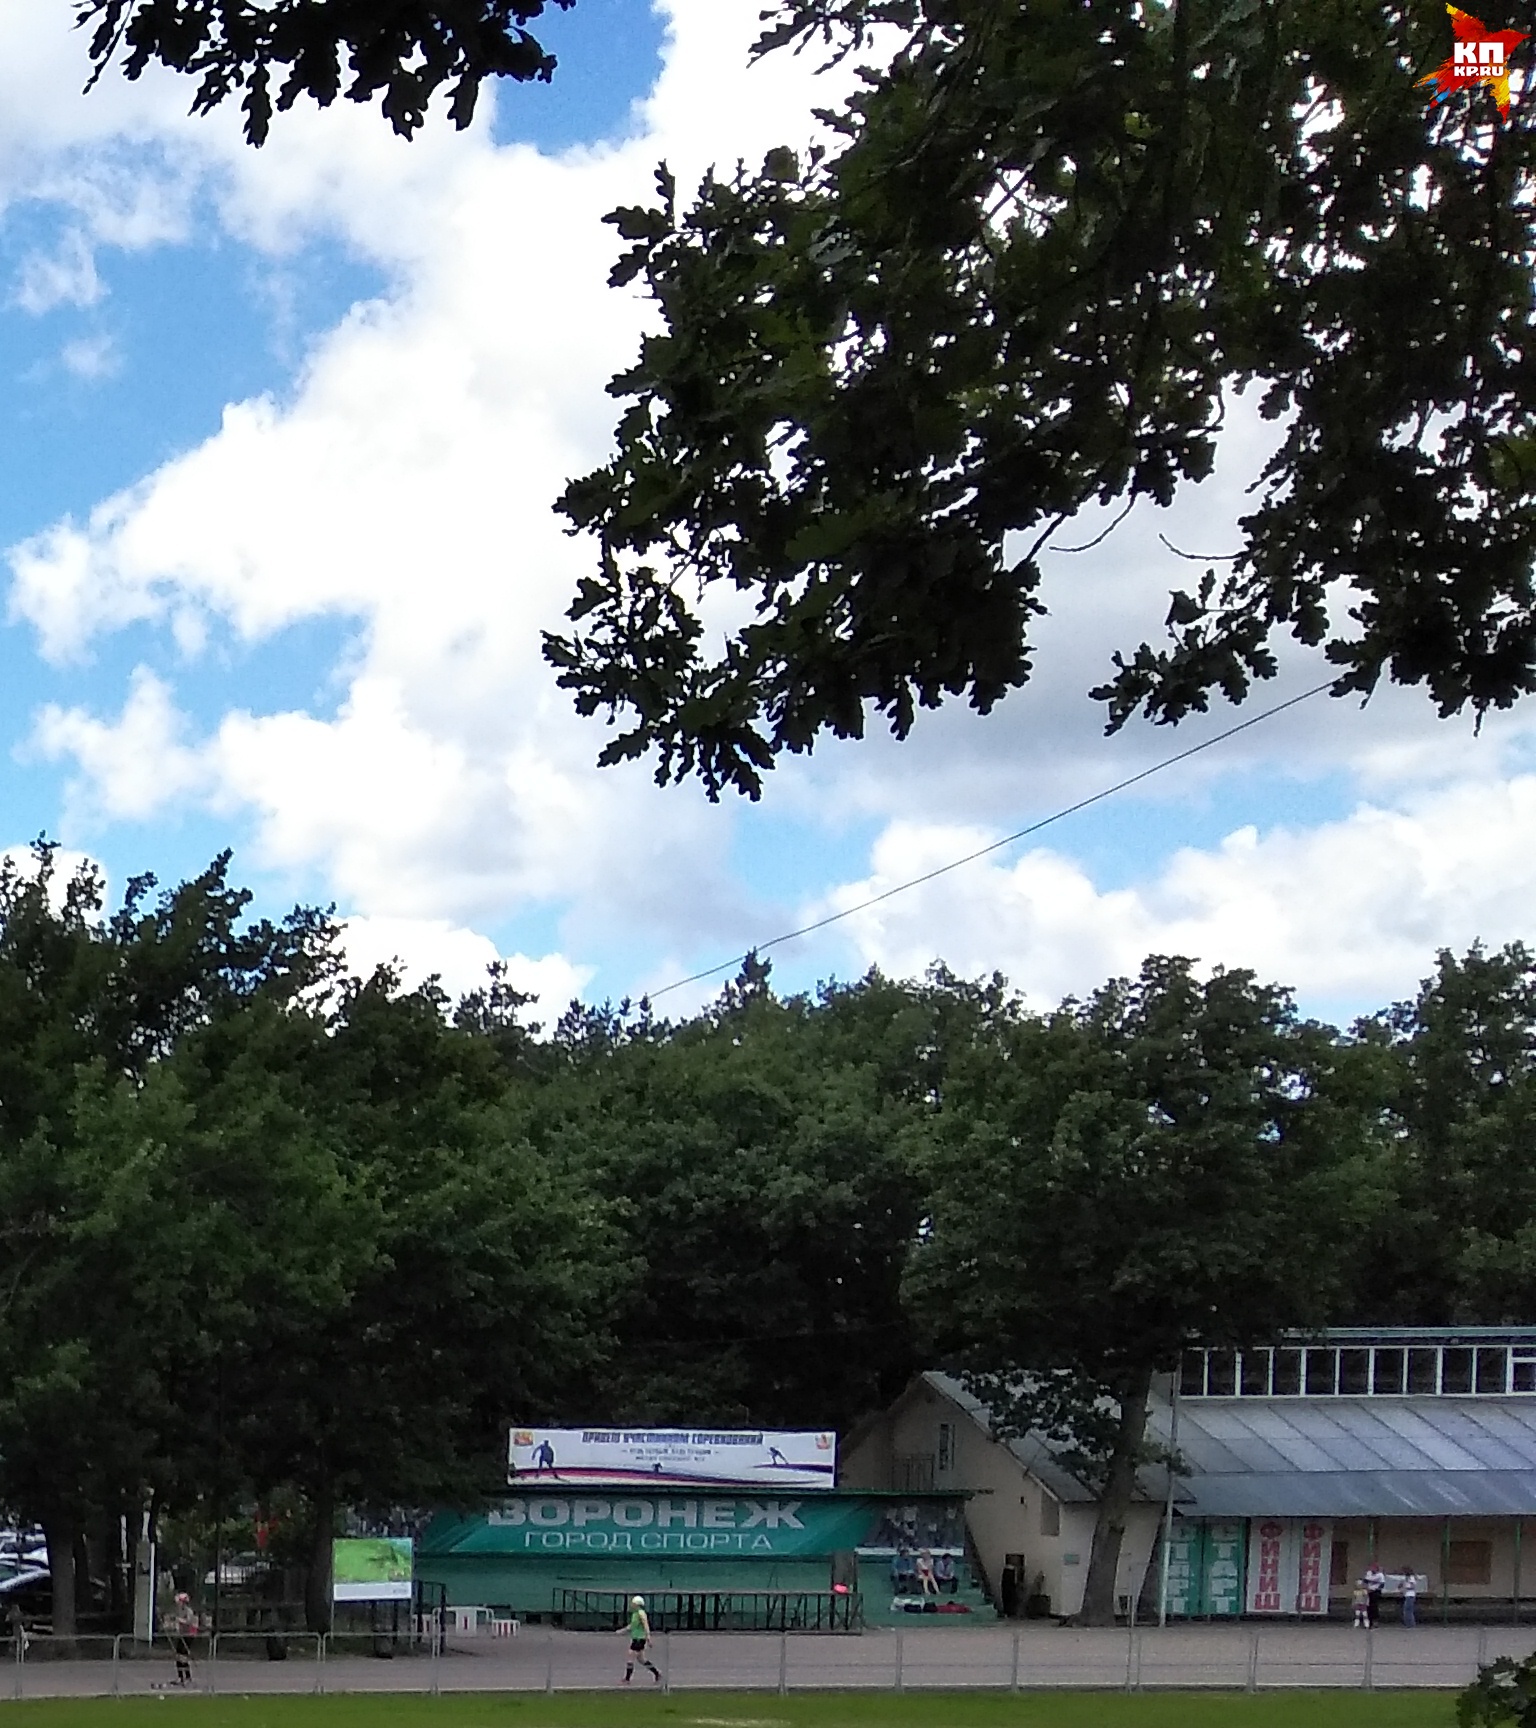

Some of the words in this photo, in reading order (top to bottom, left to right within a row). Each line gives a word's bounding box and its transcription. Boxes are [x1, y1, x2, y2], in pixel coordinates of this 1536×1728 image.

[488, 1499, 806, 1530] ВОРОНЕЖ
[524, 1531, 632, 1551] ГОРОД
[640, 1531, 774, 1550] СПОРТА
[1254, 1521, 1283, 1611] ФИНИШ
[1295, 1522, 1325, 1613] ФИНИШ
